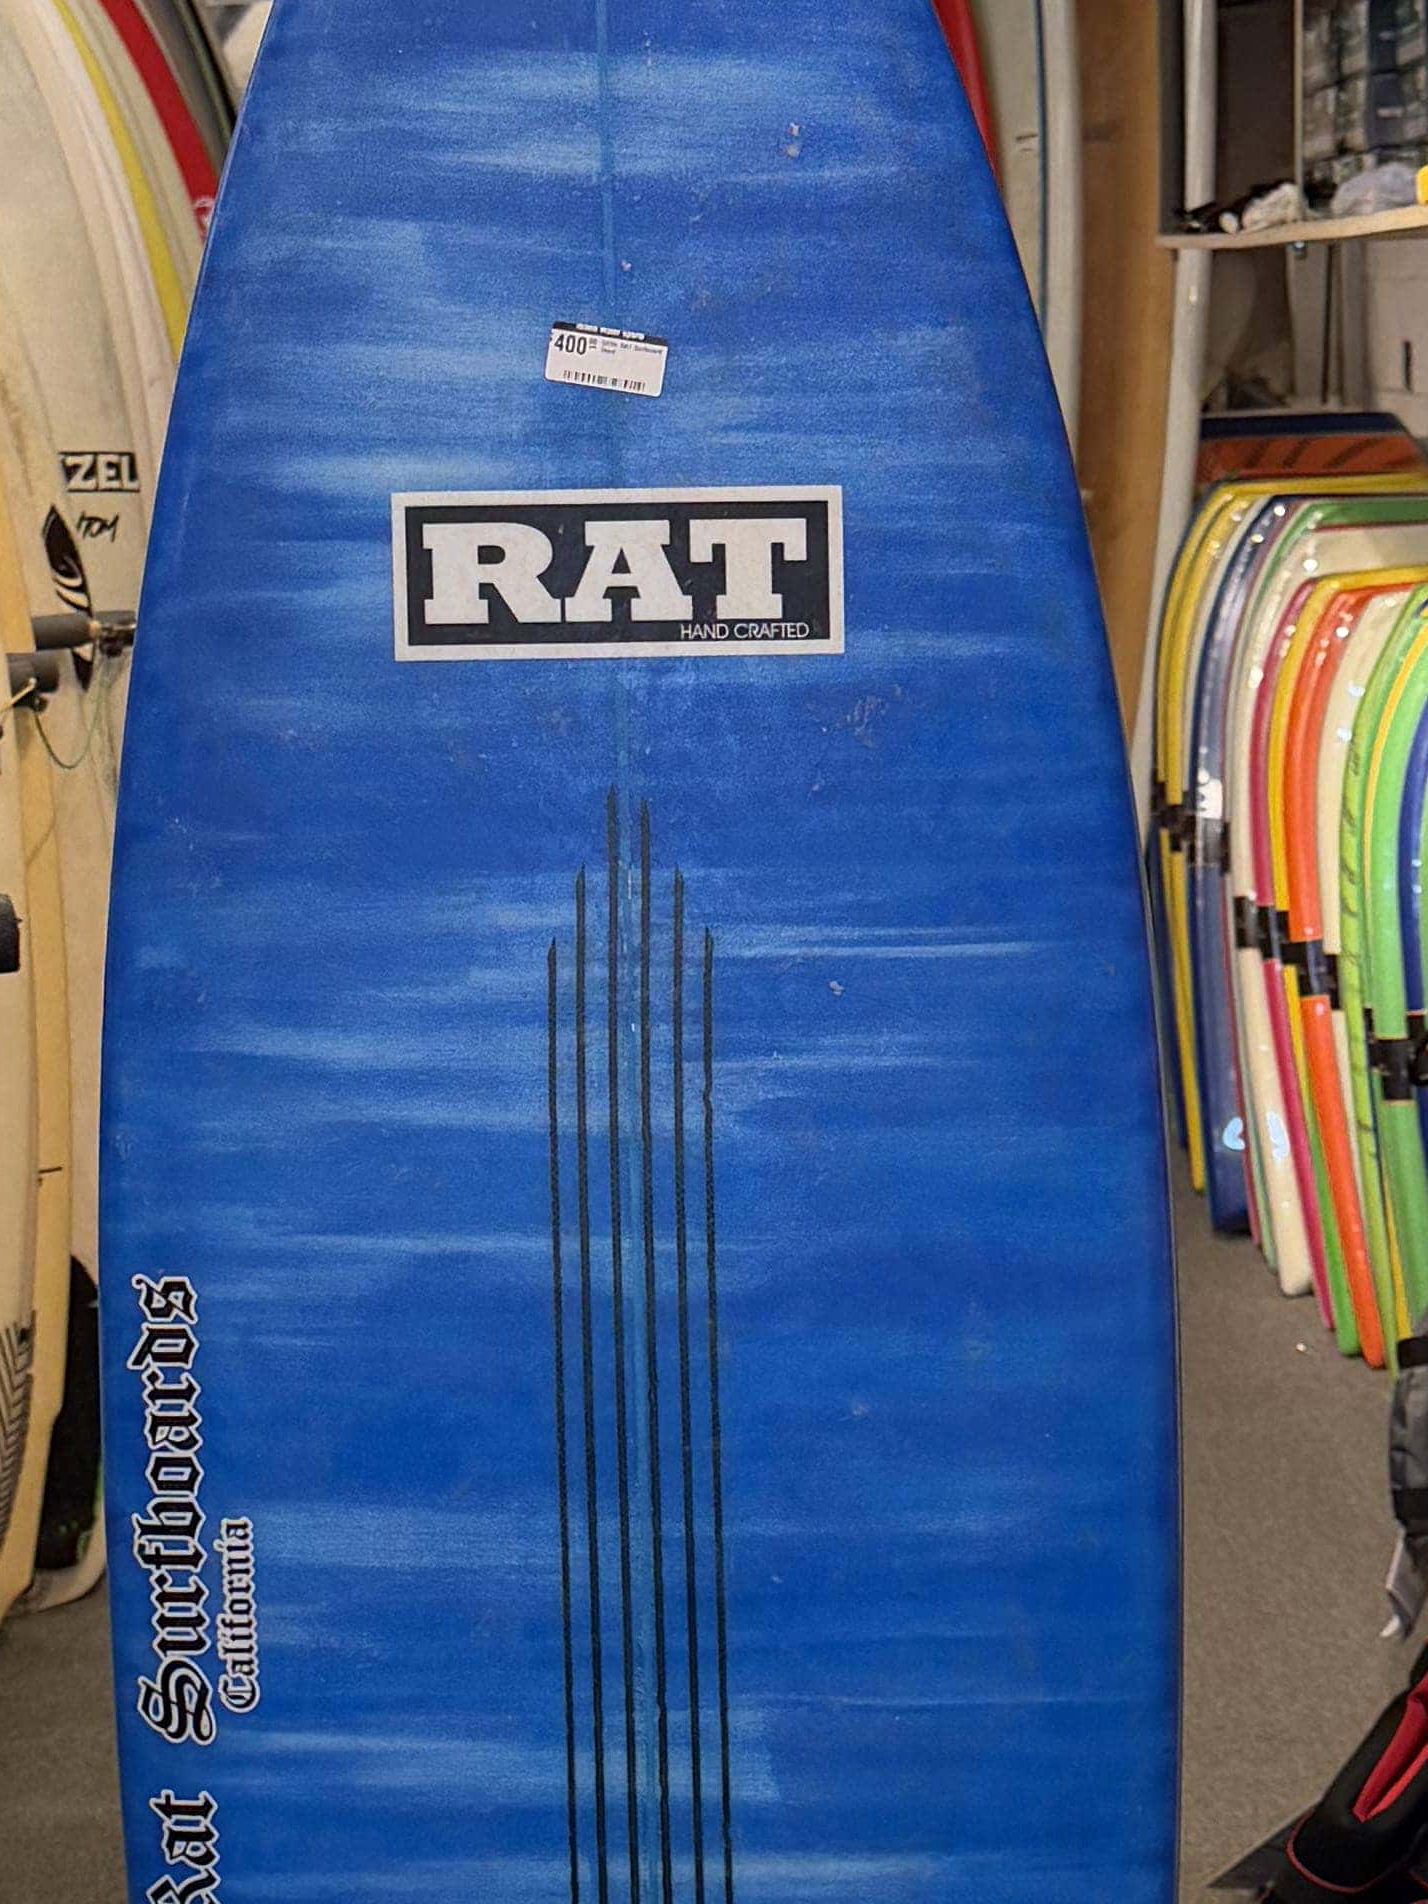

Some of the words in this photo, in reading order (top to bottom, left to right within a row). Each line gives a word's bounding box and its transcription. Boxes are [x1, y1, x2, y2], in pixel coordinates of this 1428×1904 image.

[421, 518, 808, 625] RAT
[680, 623, 729, 640] HAND
[732, 622, 811, 640] CRAFTED
[126, 1272, 217, 1748] Surfboards
[215, 1516, 261, 1714] California
